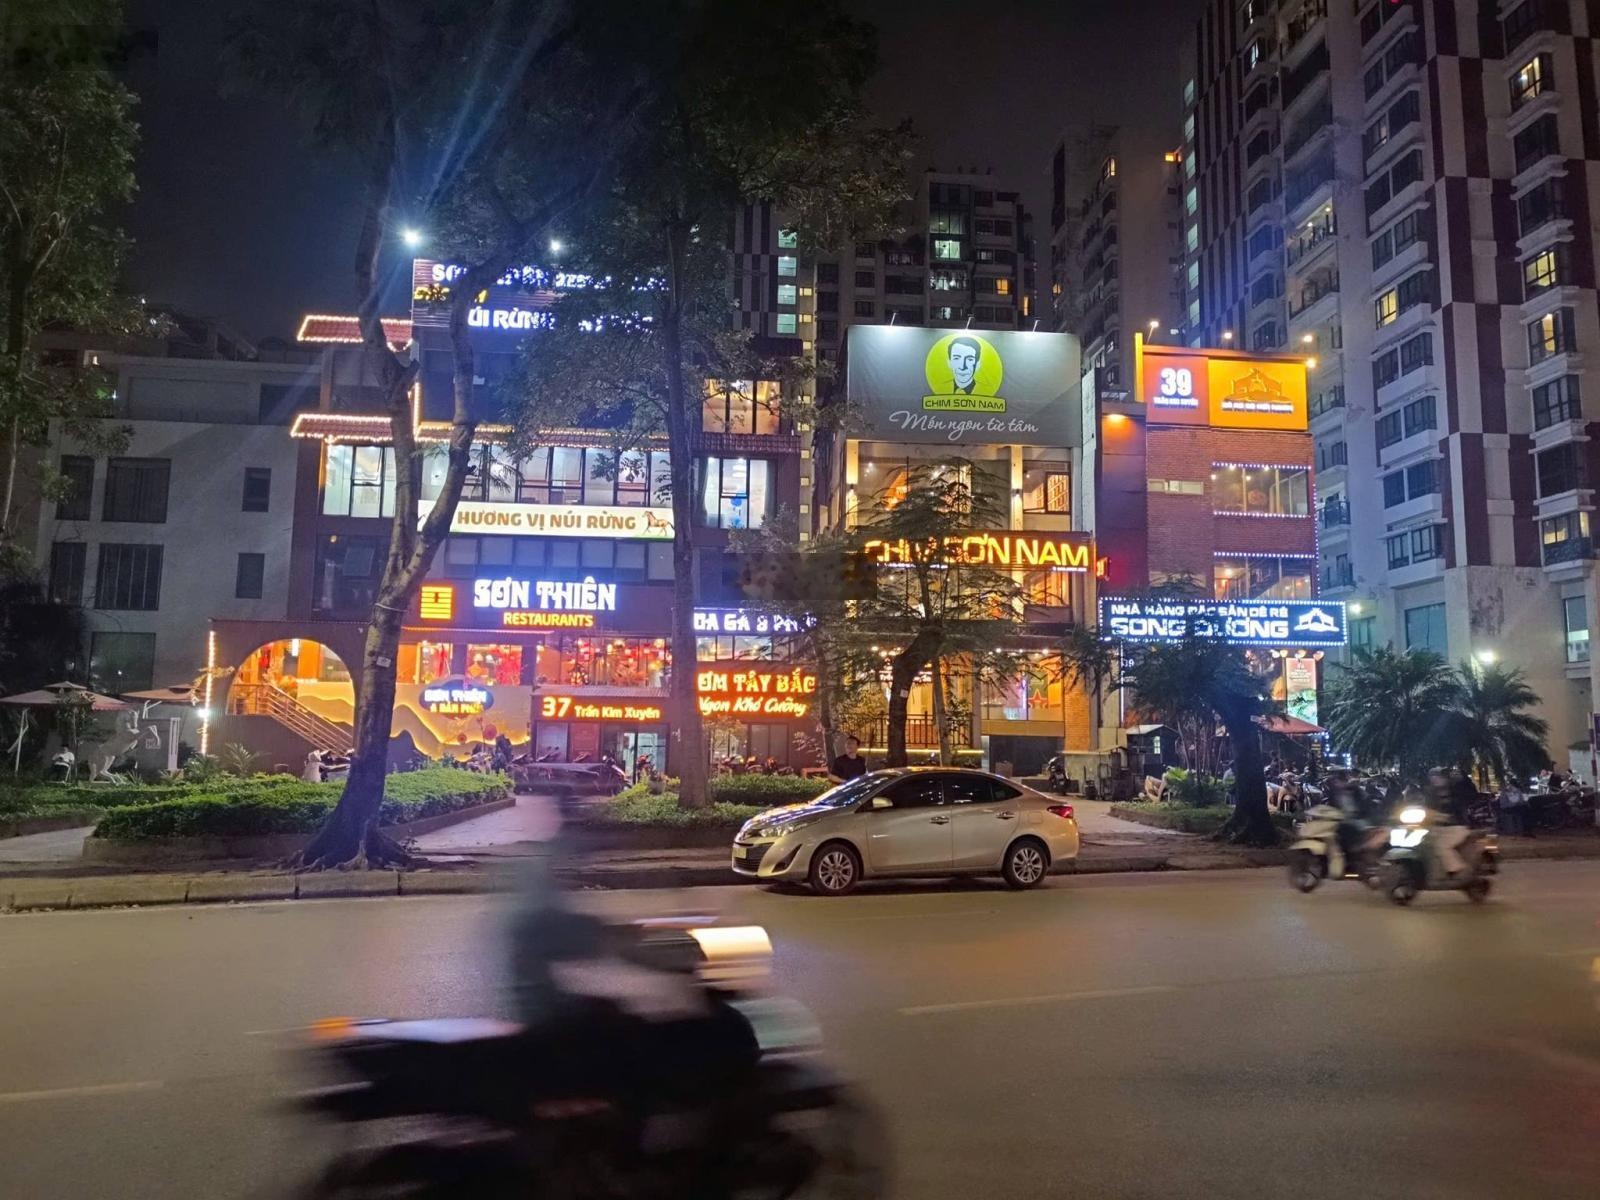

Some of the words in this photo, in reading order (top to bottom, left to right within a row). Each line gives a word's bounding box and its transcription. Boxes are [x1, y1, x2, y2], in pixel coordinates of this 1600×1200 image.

[468, 306, 489, 327] ÚI
[1160, 367, 1192, 396] 39
[924, 399, 951, 408] CHIM
[953, 398, 976, 408] SƠN
[978, 400, 1004, 410] NAM
[889, 410, 946, 430] Món
[948, 422, 985, 440] ngon
[1008, 417, 1039, 433] tâm
[457, 510, 522, 527] HƯƠNG
[527, 513, 545, 531] VỊ
[550, 510, 581, 528] NÚI
[586, 511, 636, 530] RỪNG
[944, 533, 1010, 564] SƠN
[1016, 539, 1089, 567] NAM
[473, 577, 530, 609] SƠN
[536, 576, 616, 611] THIÊN
[503, 612, 594, 628] RESTAURANTS
[1111, 603, 1140, 615] NHÀ
[1145, 603, 1185, 616] HÀNG
[1110, 617, 1186, 637] SONG
[697, 671, 728, 692] ƠM
[733, 670, 771, 693] TÂY
[776, 667, 816, 693] BẮC
[542, 696, 572, 717] 37
[602, 706, 623, 718] Kim
